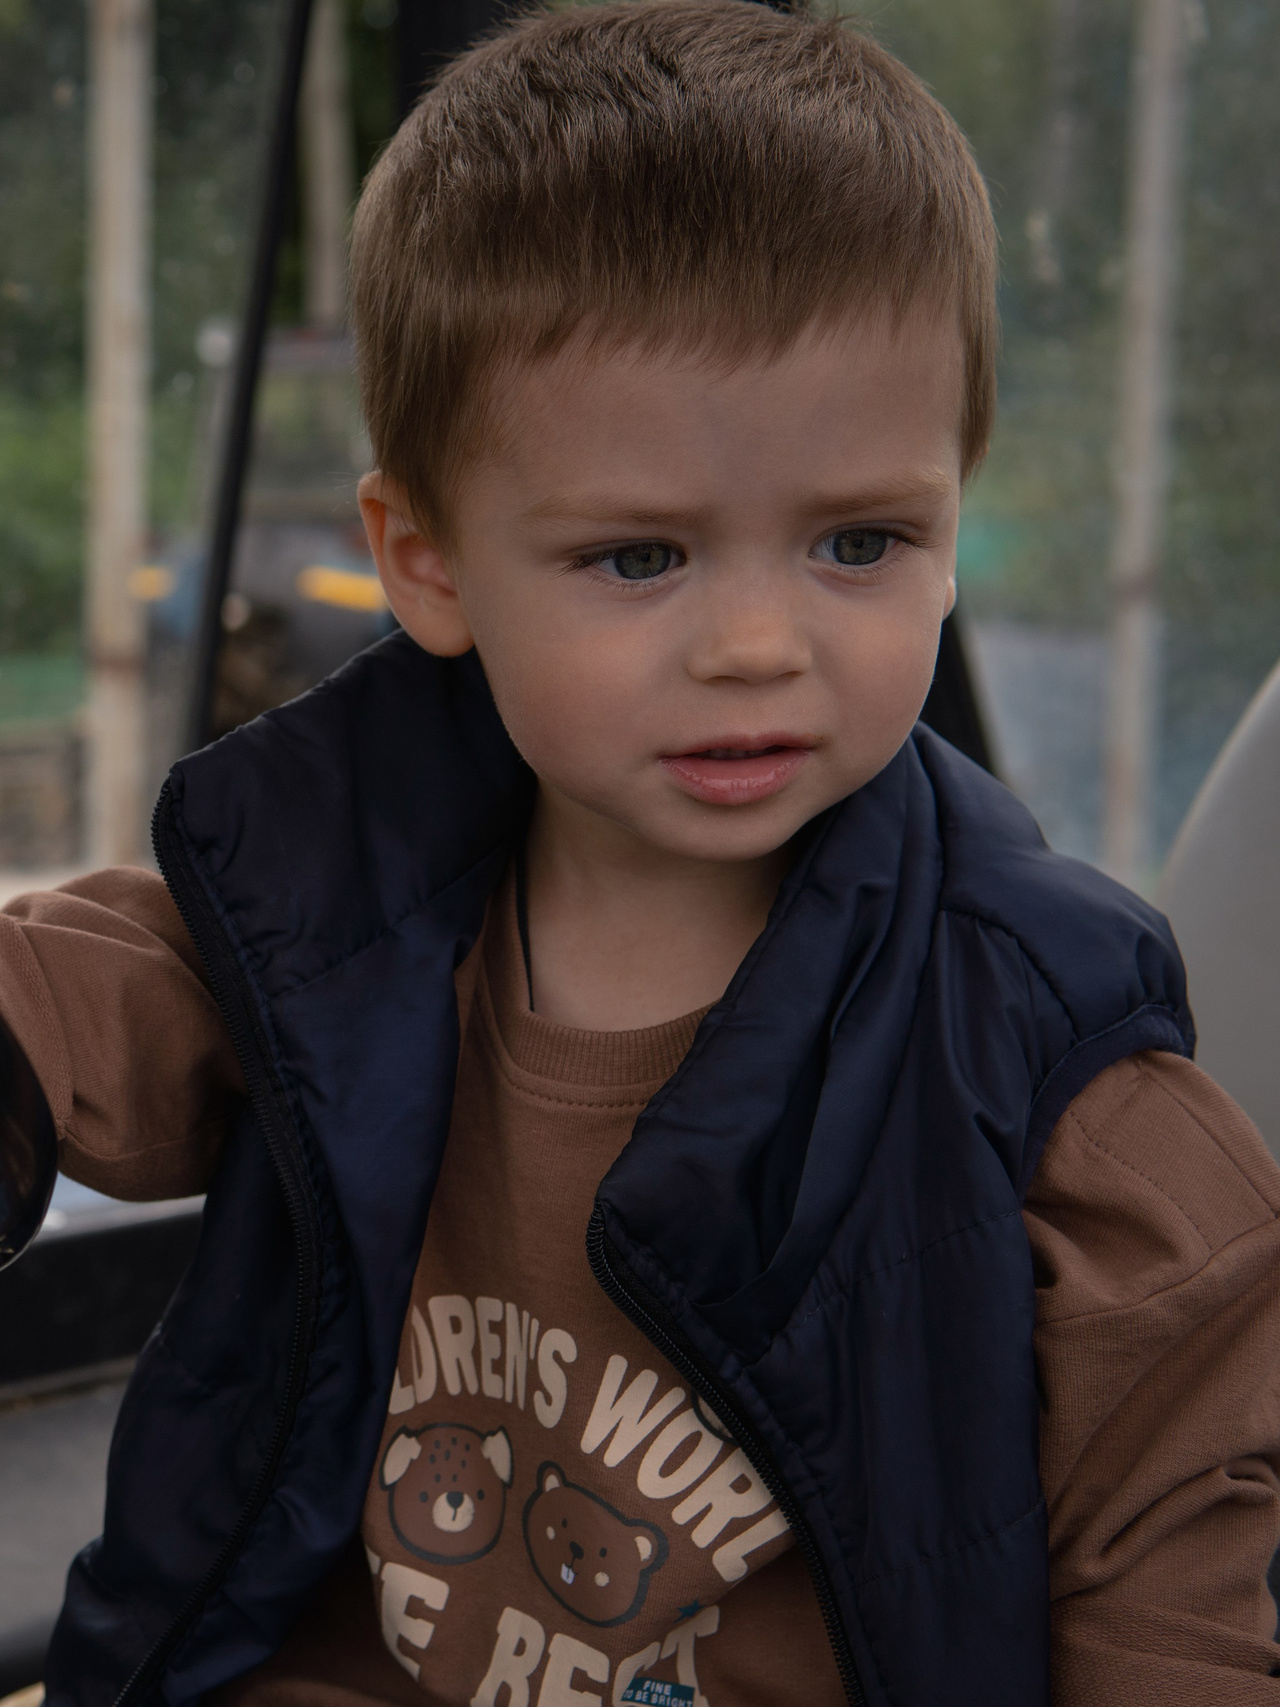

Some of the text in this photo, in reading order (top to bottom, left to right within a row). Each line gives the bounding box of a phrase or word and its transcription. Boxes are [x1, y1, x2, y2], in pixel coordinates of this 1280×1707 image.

[642, 1680, 673, 1696] FINE
[634, 1690, 650, 1703] BE
[650, 1693, 694, 1707] BRIGHT
